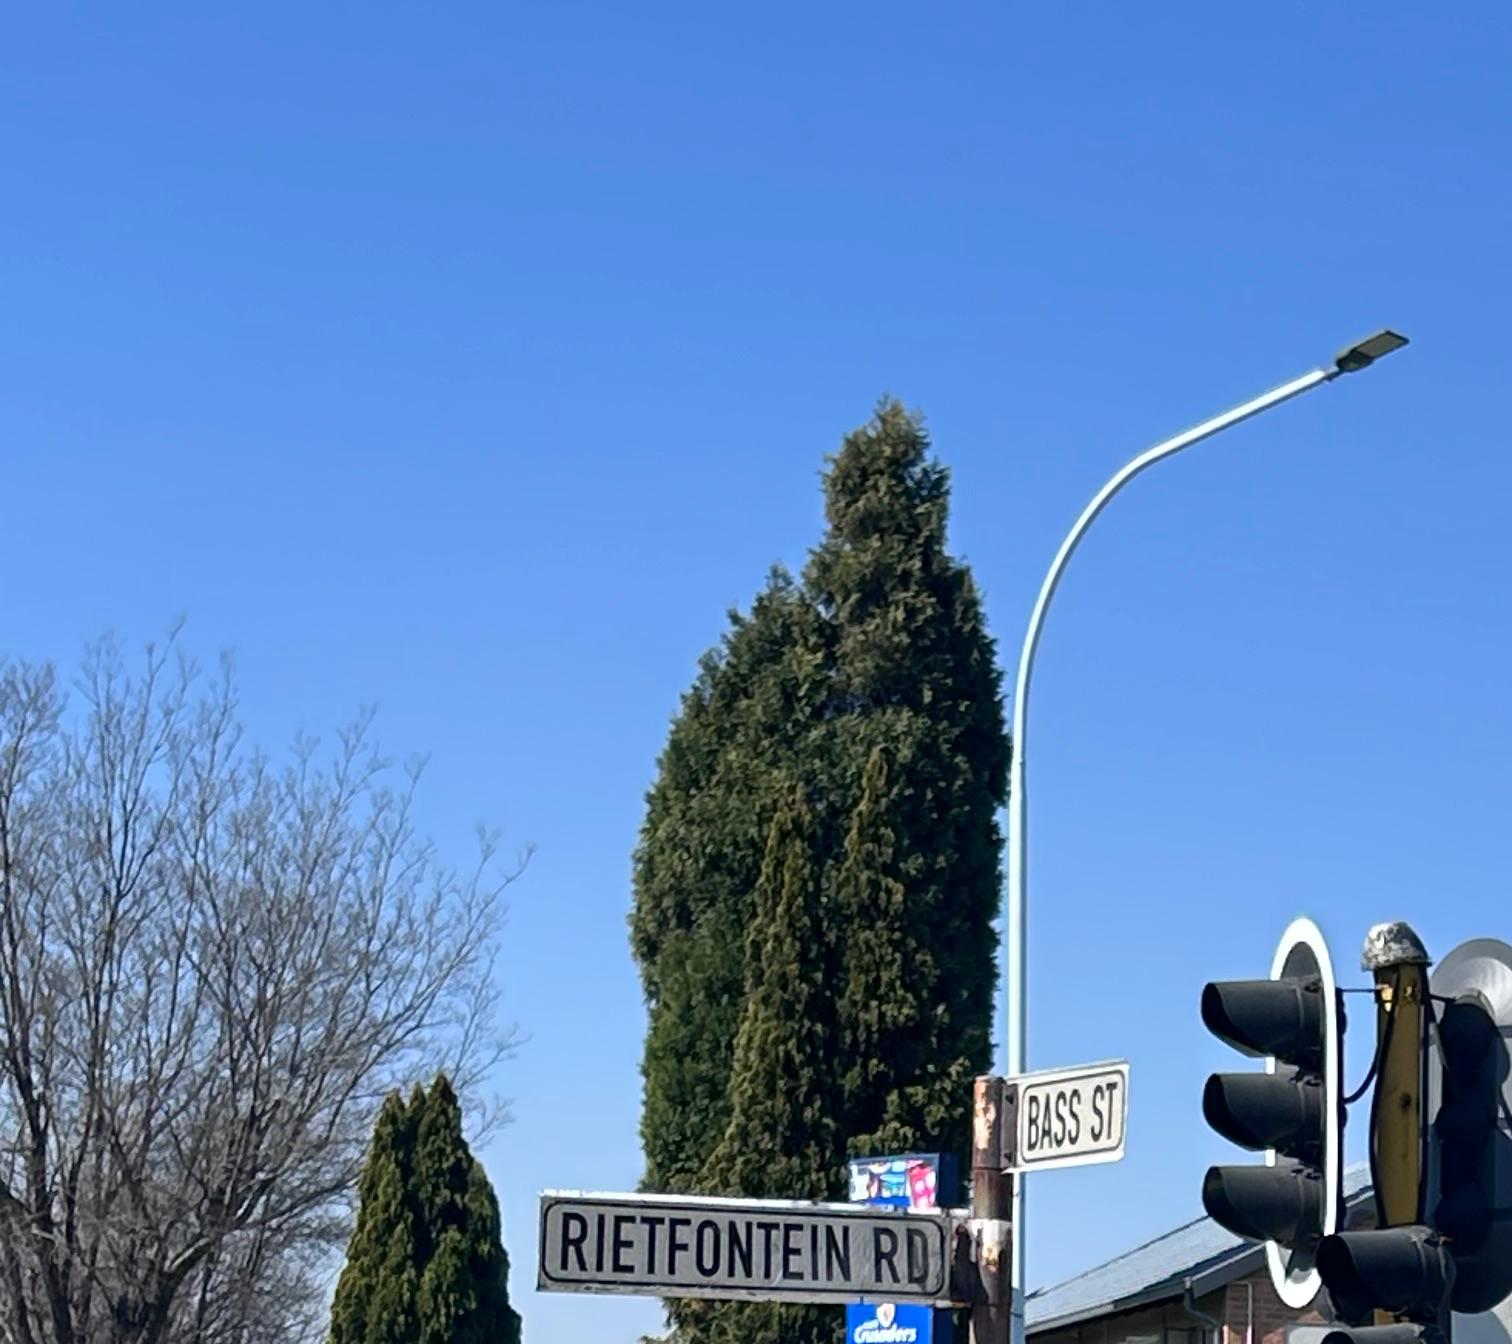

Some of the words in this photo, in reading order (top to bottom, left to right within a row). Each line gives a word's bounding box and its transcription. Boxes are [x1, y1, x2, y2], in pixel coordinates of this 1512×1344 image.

[1027, 1088, 1081, 1151] BASS
[1091, 1082, 1118, 1142] ST
[560, 1212, 851, 1282] RIETFONTEIN
[874, 1227, 929, 1289] RD
